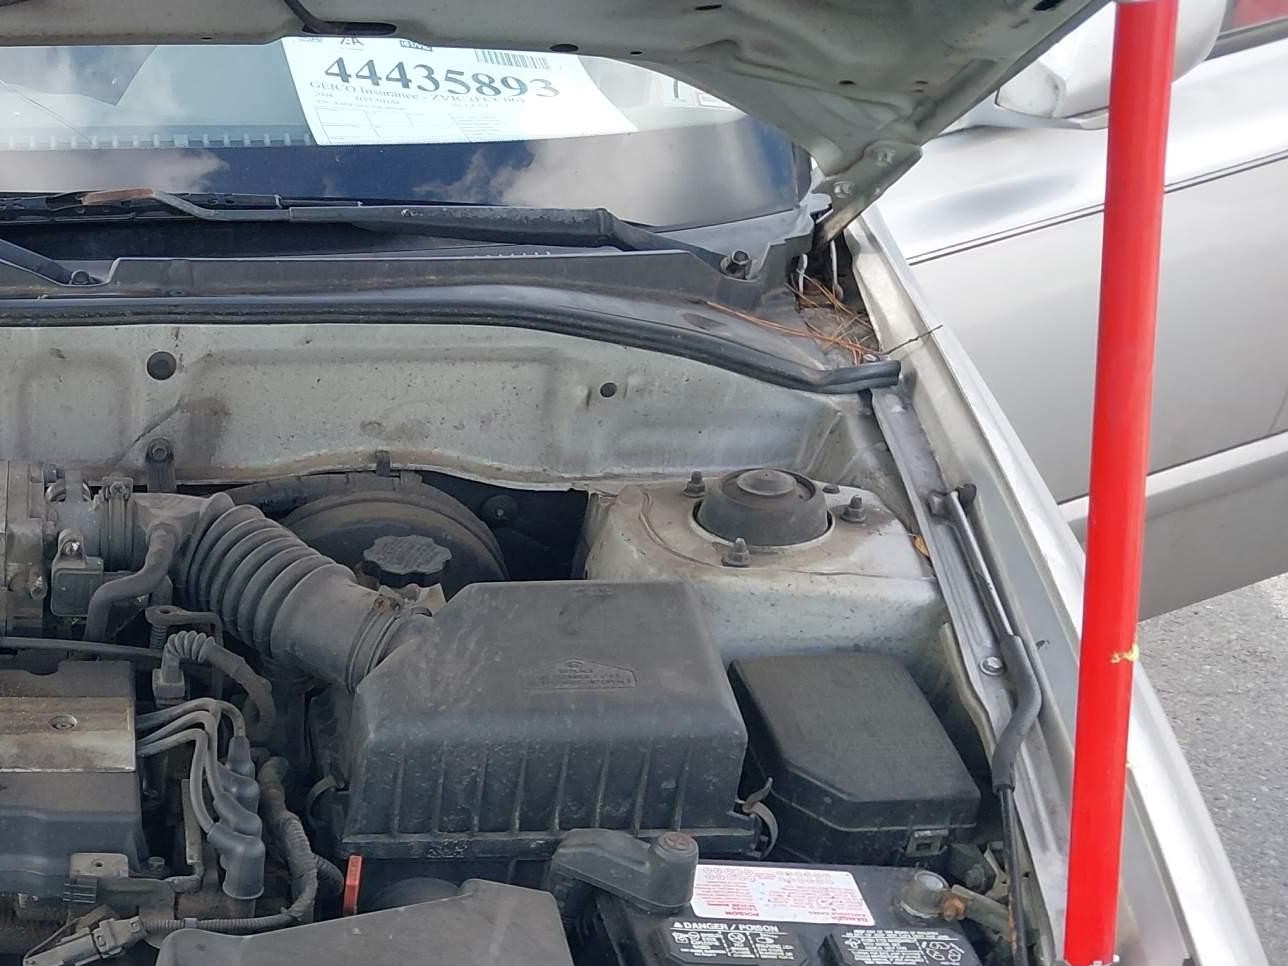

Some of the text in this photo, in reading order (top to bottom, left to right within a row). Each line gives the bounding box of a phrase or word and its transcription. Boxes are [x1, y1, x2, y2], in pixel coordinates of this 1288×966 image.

[324, 56, 560, 97] 44435893
[309, 81, 357, 93] GEICO
[360, 86, 419, 100] Insurance
[682, 922, 729, 931] DANGER
[738, 923, 780, 932] POISON
